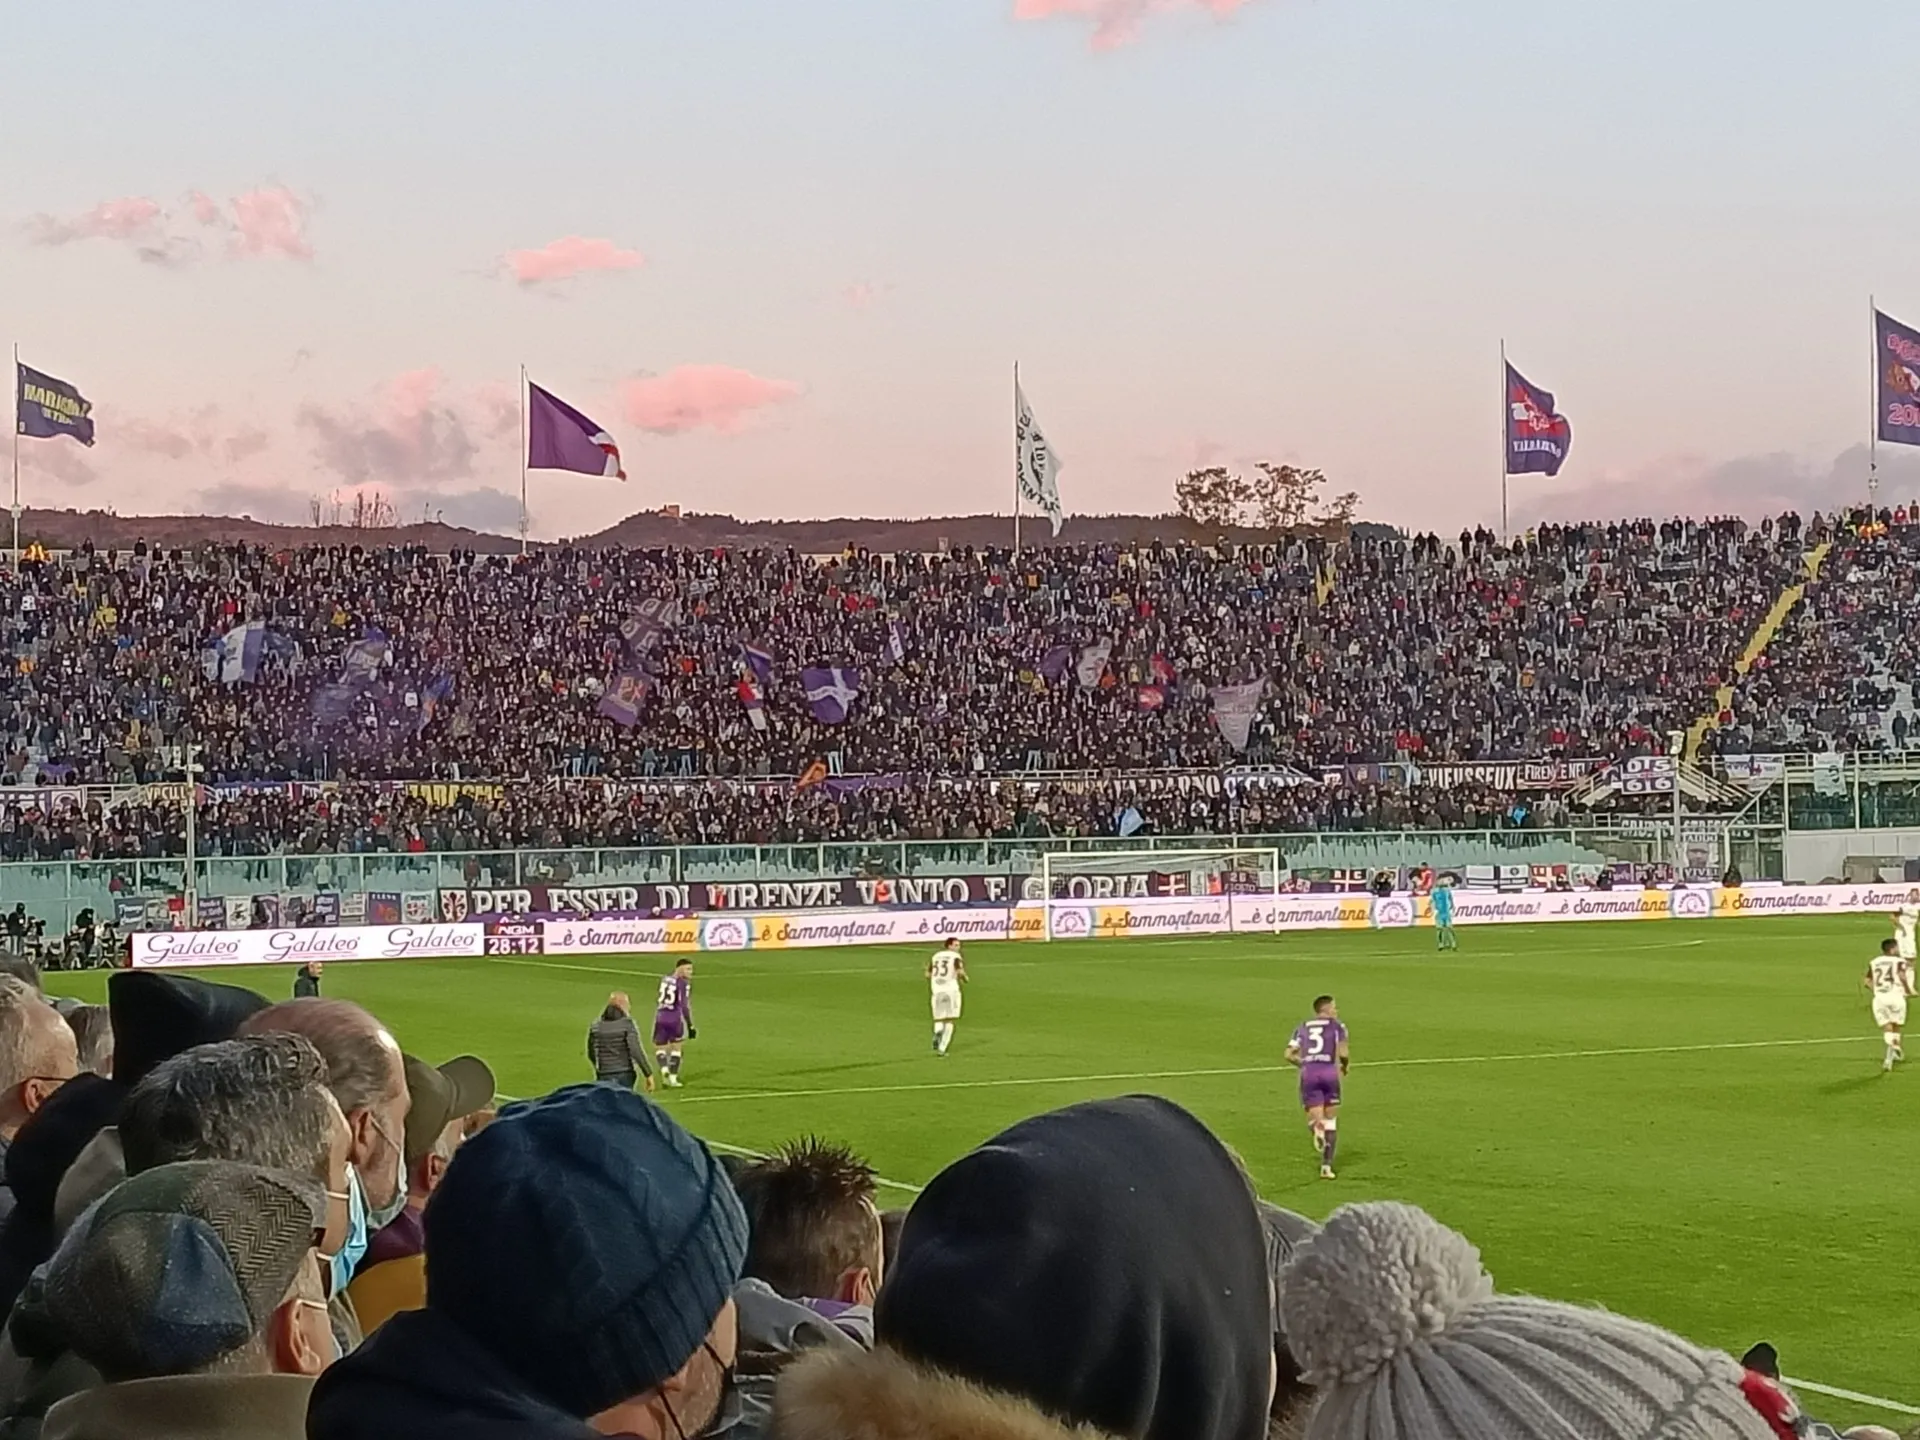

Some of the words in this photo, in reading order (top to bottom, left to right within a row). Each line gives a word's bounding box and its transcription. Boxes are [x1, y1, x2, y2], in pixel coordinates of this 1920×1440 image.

[471, 889, 533, 914] PER
[546, 886, 639, 913] ESSER
[655, 884, 689, 909] DI
[984, 876, 1007, 901] E
[141, 934, 240, 964] Galateo
[263, 931, 360, 961] Galateo
[381, 927, 476, 957] Galateo
[488, 937, 540, 955] 28:12
[1875, 967, 1894, 987] 24
[1308, 1027, 1324, 1054] 3
